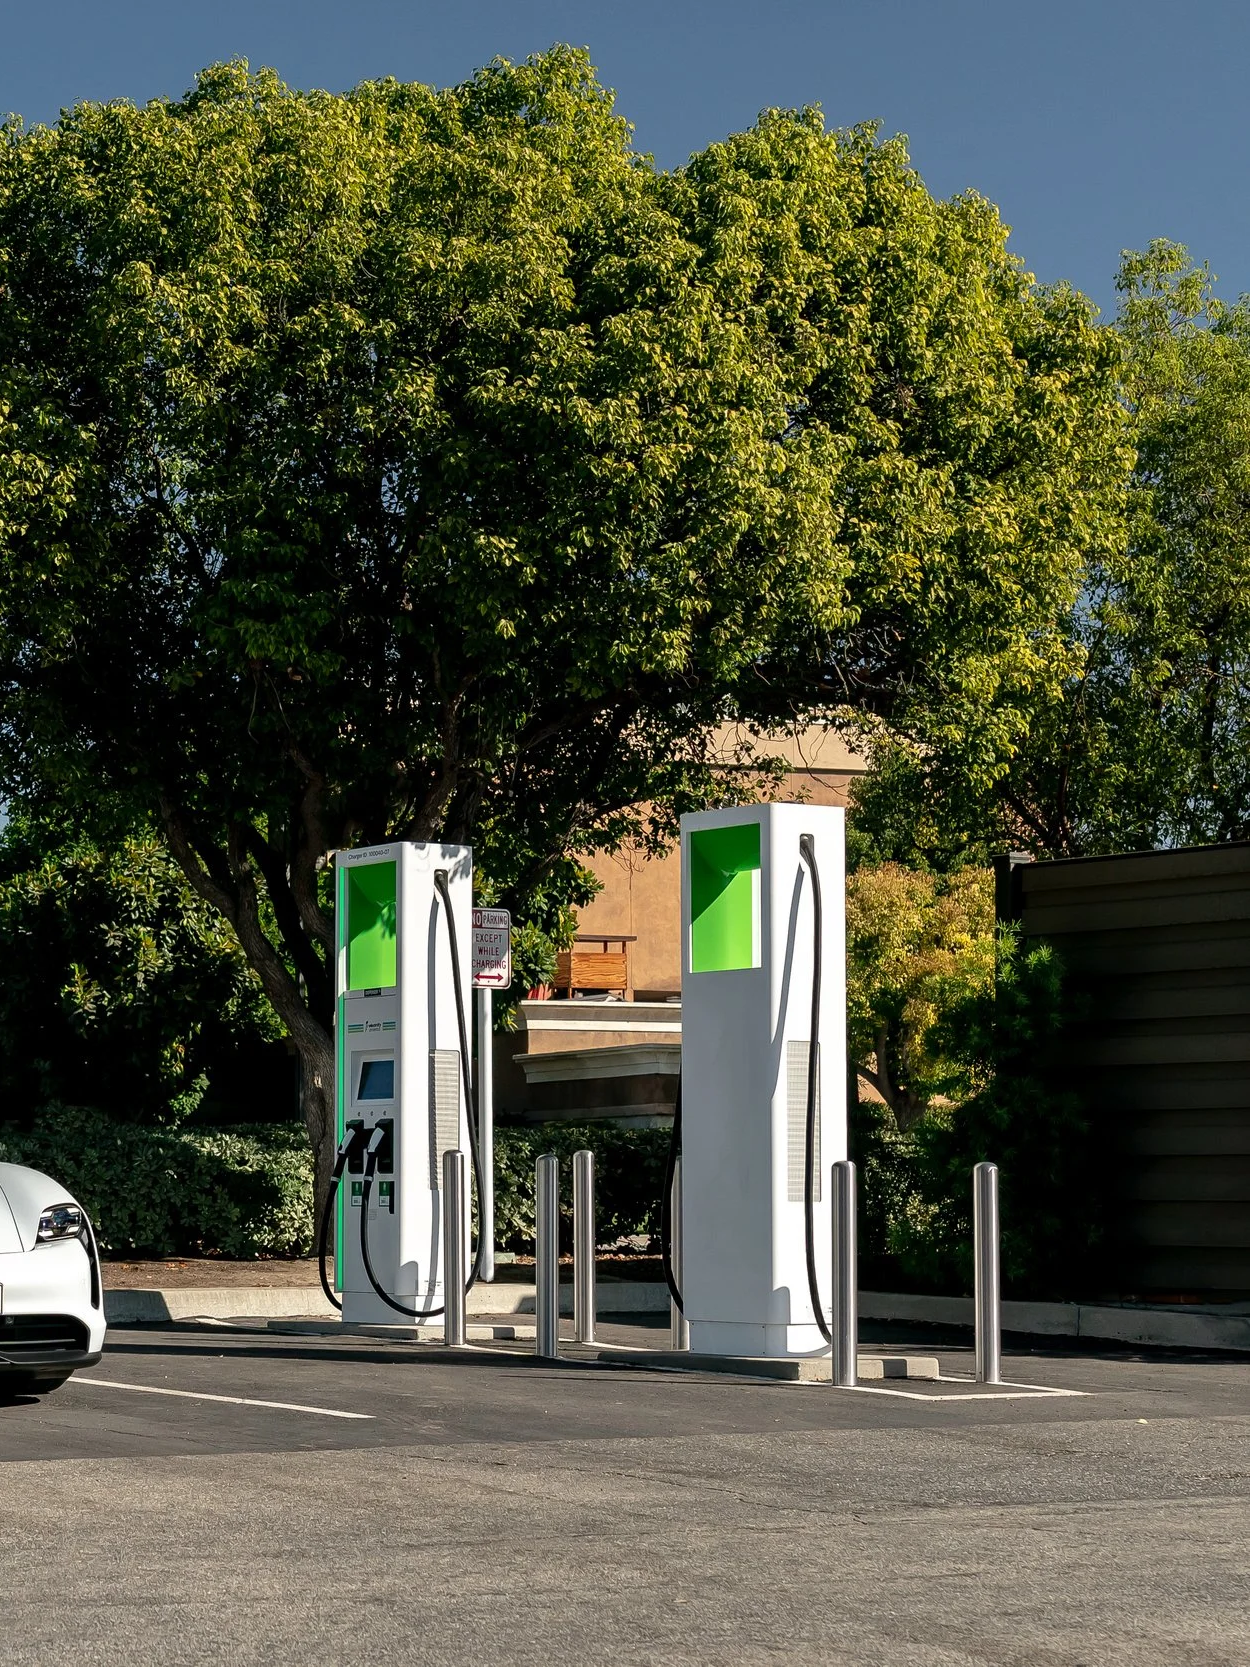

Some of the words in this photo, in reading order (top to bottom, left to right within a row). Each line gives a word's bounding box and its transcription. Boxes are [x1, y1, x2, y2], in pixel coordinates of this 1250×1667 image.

[482, 913, 508, 925] PARKING
[476, 933, 502, 943] EXCEPT
[478, 946, 499, 956] WHILE
[472, 959, 506, 969] CHARGING
